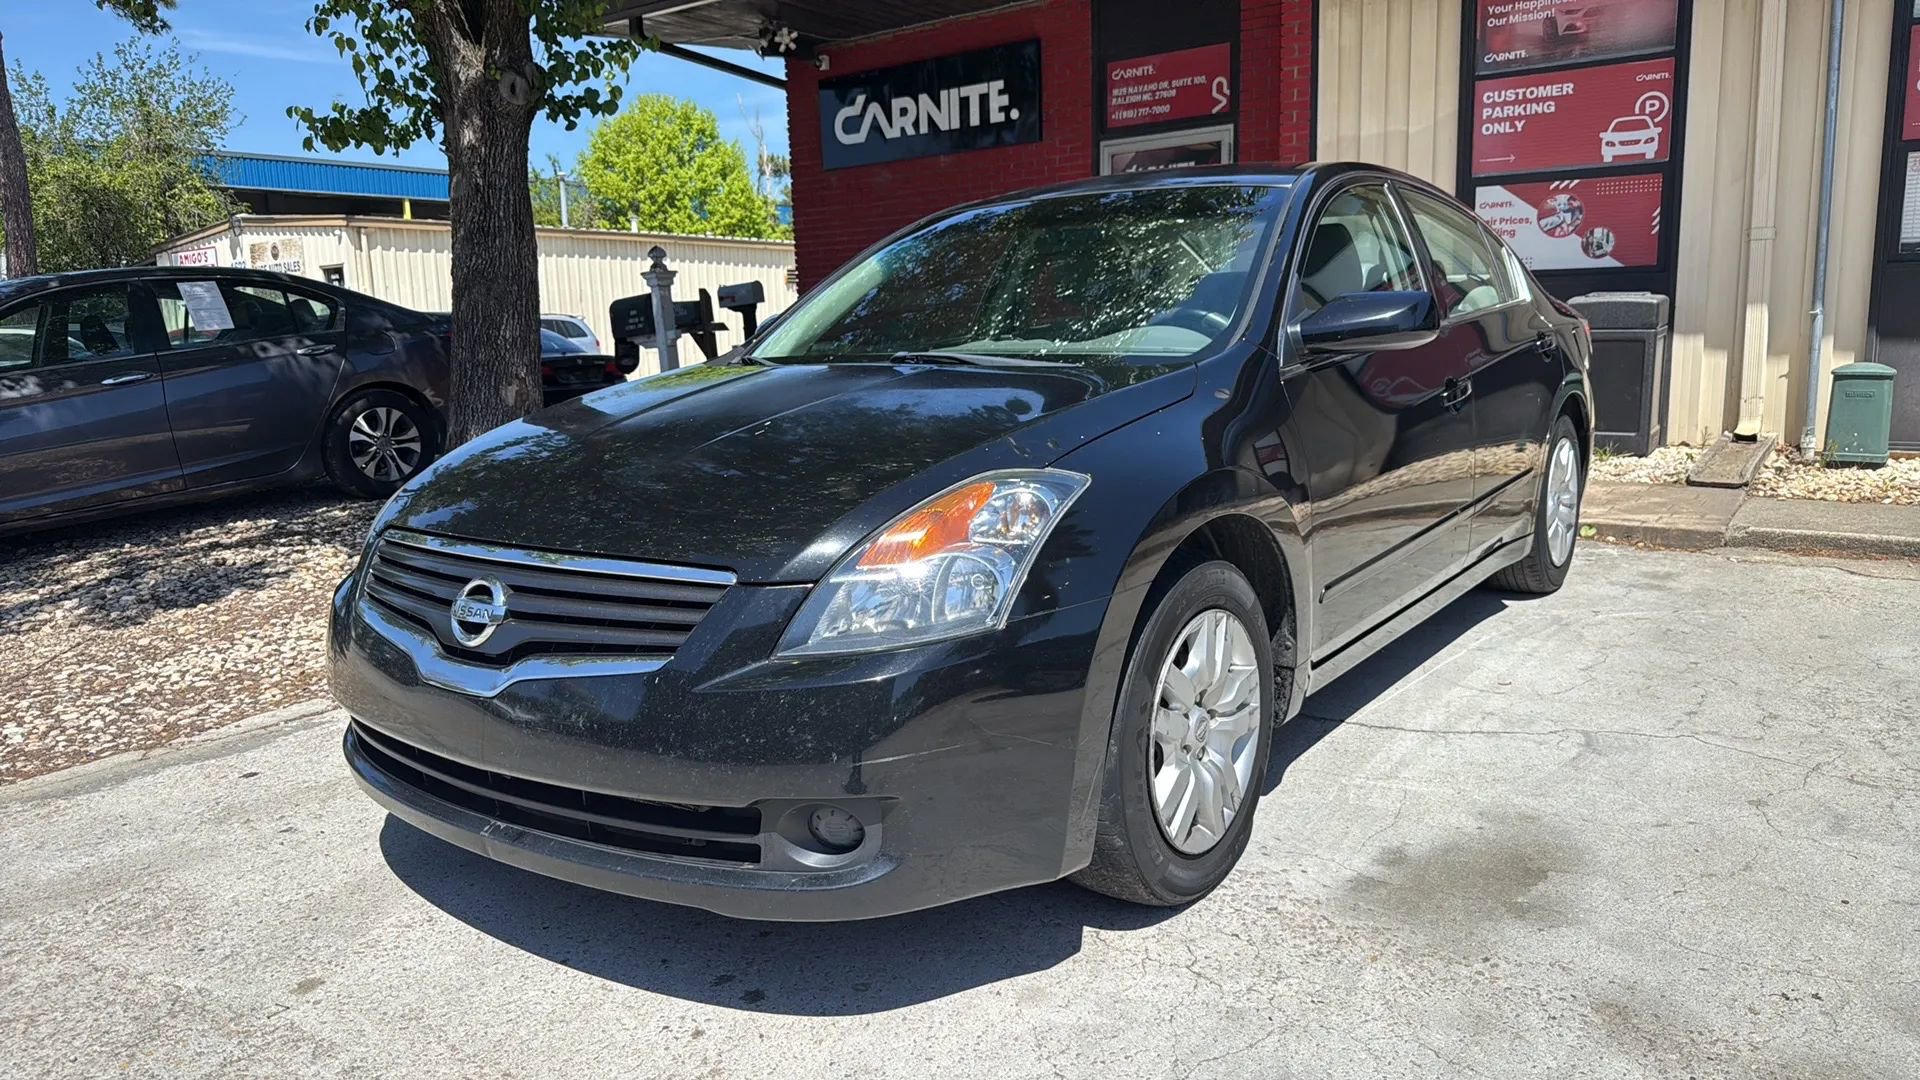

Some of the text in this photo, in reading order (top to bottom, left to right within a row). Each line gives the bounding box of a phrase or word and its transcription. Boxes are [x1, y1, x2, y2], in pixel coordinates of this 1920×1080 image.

[1487, 4, 1513, 15] Your
[1487, 8, 1555, 28] Our Mission!
[1171, 76, 1193, 88] SUITE
[1483, 82, 1575, 104] CUSTOMER
[1482, 101, 1556, 120] PARKING
[1482, 120, 1525, 135] ONLY
[1499, 216, 1533, 226] Prices,
[179, 251, 208, 265] AMIGO'S
[283, 261, 301, 274] SALES
[453, 603, 496, 619] NISSAN
